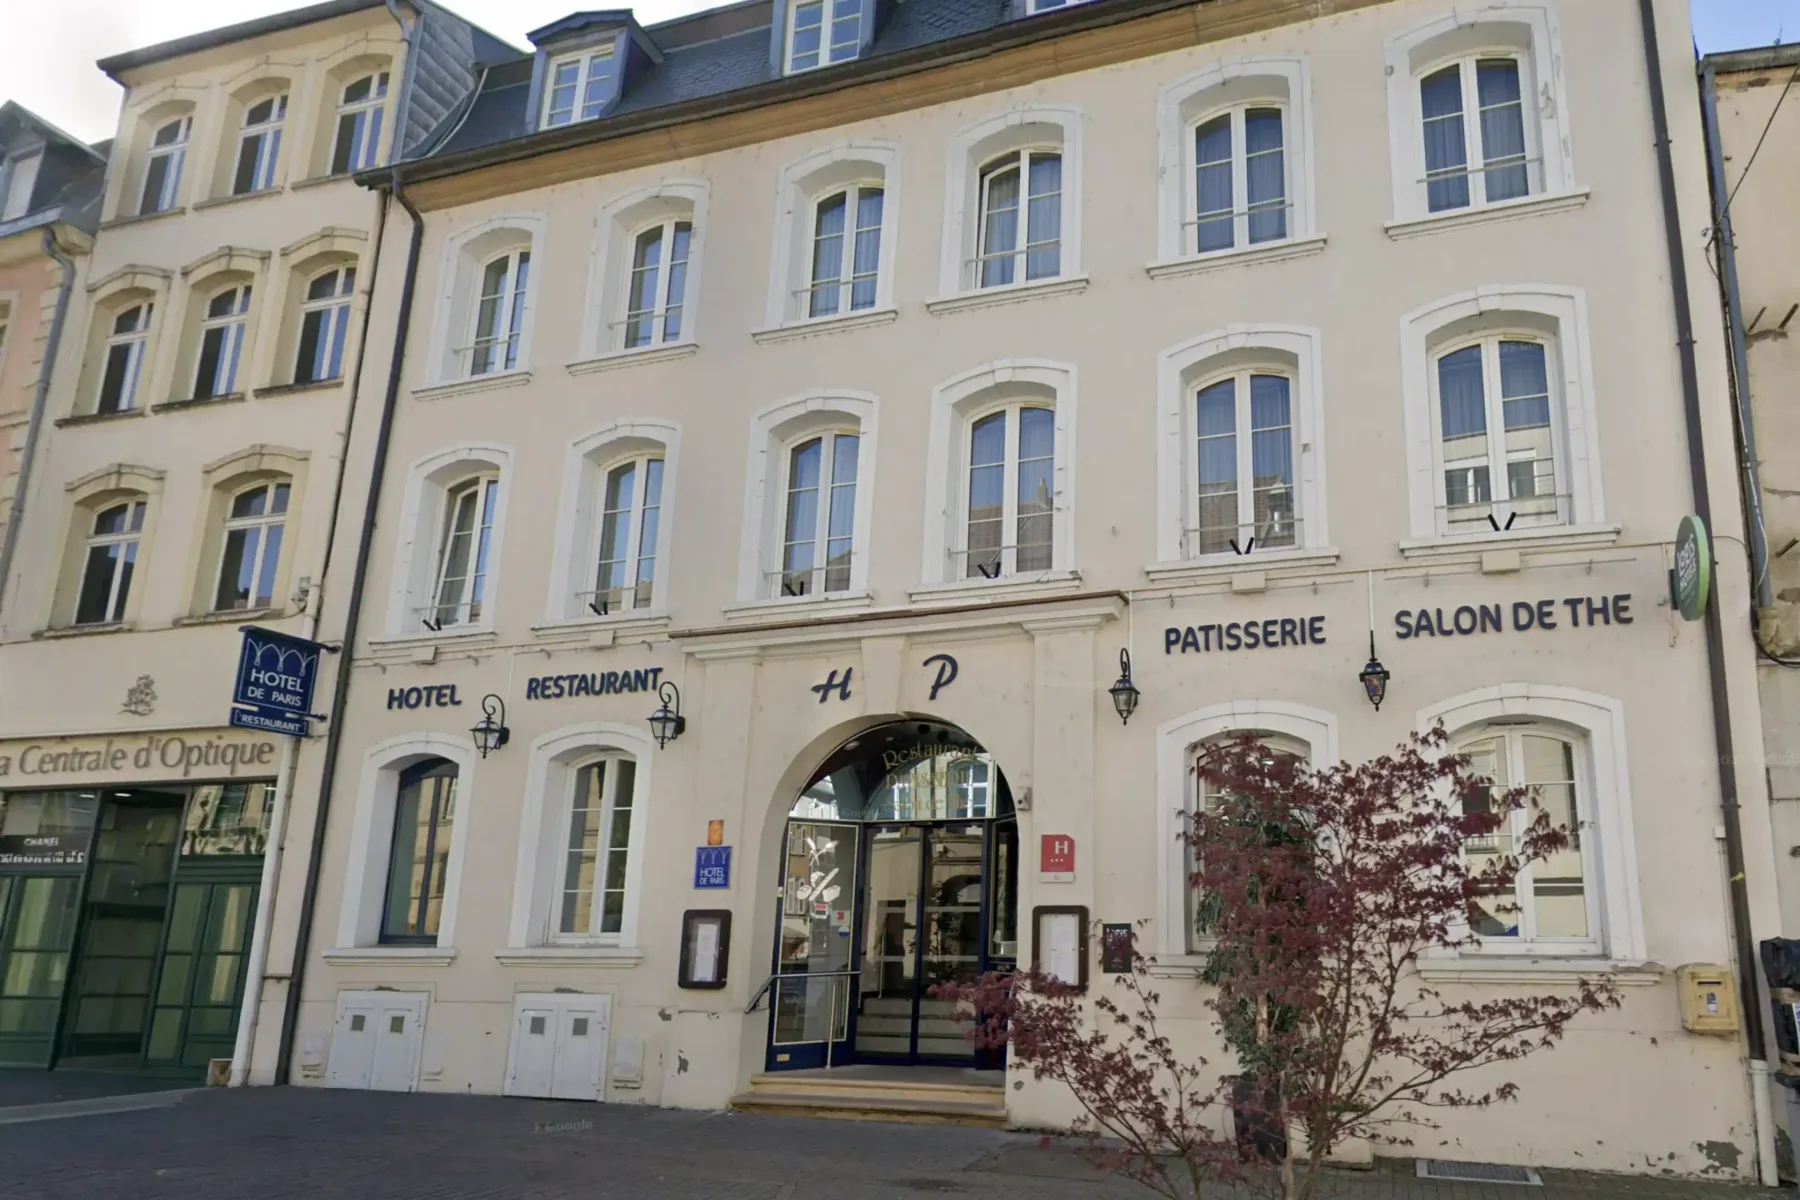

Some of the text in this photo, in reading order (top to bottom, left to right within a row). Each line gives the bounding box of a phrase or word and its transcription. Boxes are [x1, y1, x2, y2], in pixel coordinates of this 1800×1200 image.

[1394, 593, 1635, 640] SALON DE THE
[1164, 615, 1327, 655] PATISSERIE
[250, 668, 304, 692] HOTEL
[526, 667, 663, 700] RESTAURANT
[810, 653, 959, 704] H P
[246, 686, 302, 707] DE PARIS
[386, 683, 463, 711] HOTEL
[241, 714, 300, 732] RESTAURANT
[18, 739, 128, 775] Centrale
[133, 735, 275, 777] d'Optique
[881, 741, 979, 771] Restaurant
[1055, 840, 1068, 855] H
[700, 866, 724, 878] HOTEL
